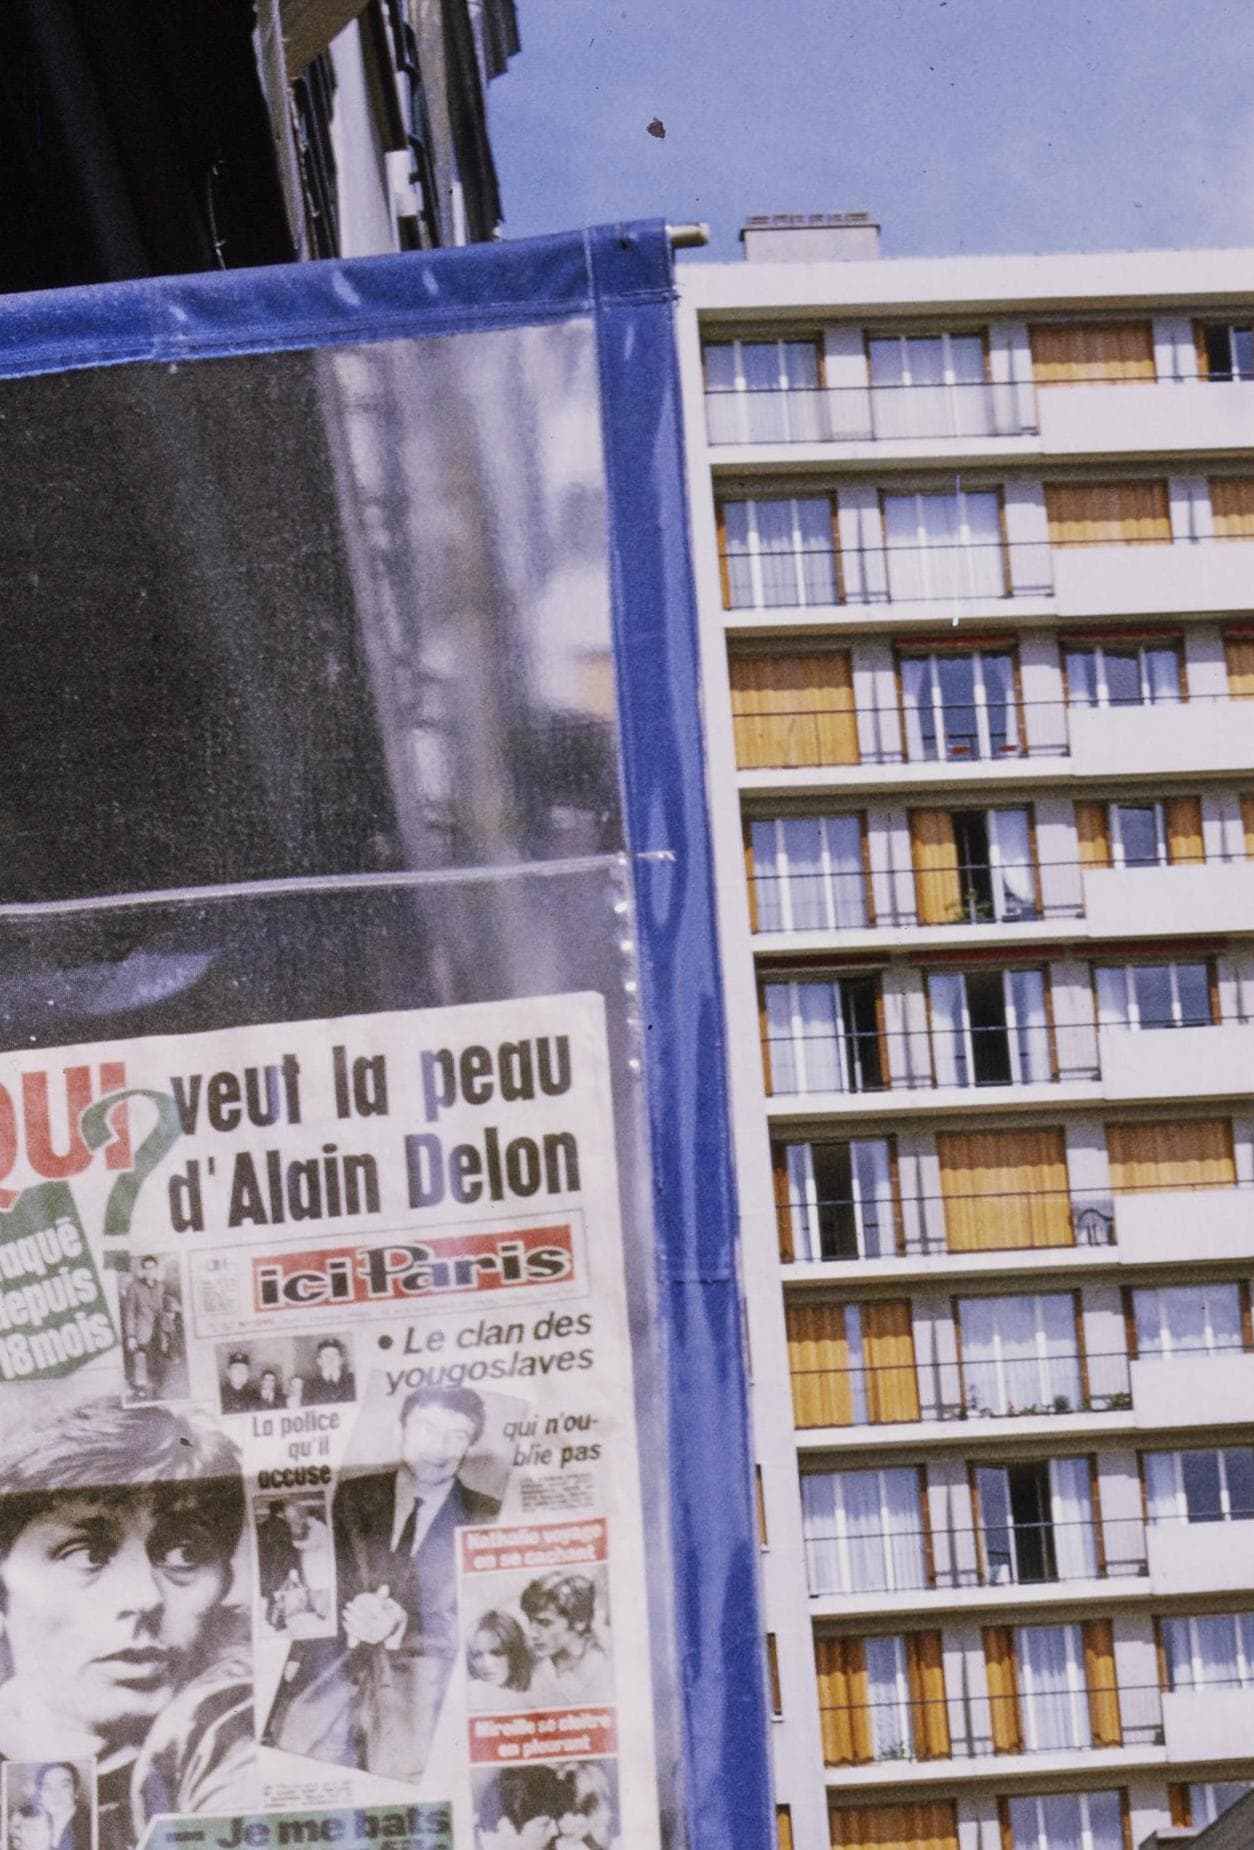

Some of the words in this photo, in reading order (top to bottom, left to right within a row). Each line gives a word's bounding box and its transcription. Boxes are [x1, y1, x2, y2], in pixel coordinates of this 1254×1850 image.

[170, 1054, 301, 1135] veut
[332, 1045, 389, 1118] la
[420, 1035, 572, 1122] peau
[168, 1143, 381, 1233] d'Alain
[404, 1127, 581, 1209] Delon
[358, 1245, 571, 1295] Paris
[404, 1326, 445, 1354] Le
[456, 1320, 524, 1348] clan
[533, 1311, 592, 1341] des
[385, 1349, 594, 1396] yougoslaves
[281, 1409, 340, 1438] police
[503, 1414, 539, 1441] qui
[258, 1464, 331, 1489] accuse
[559, 1442, 602, 1469] pas
[217, 1816, 270, 1849] Je
[278, 1816, 345, 1845] me
[354, 1807, 449, 1839] bats
